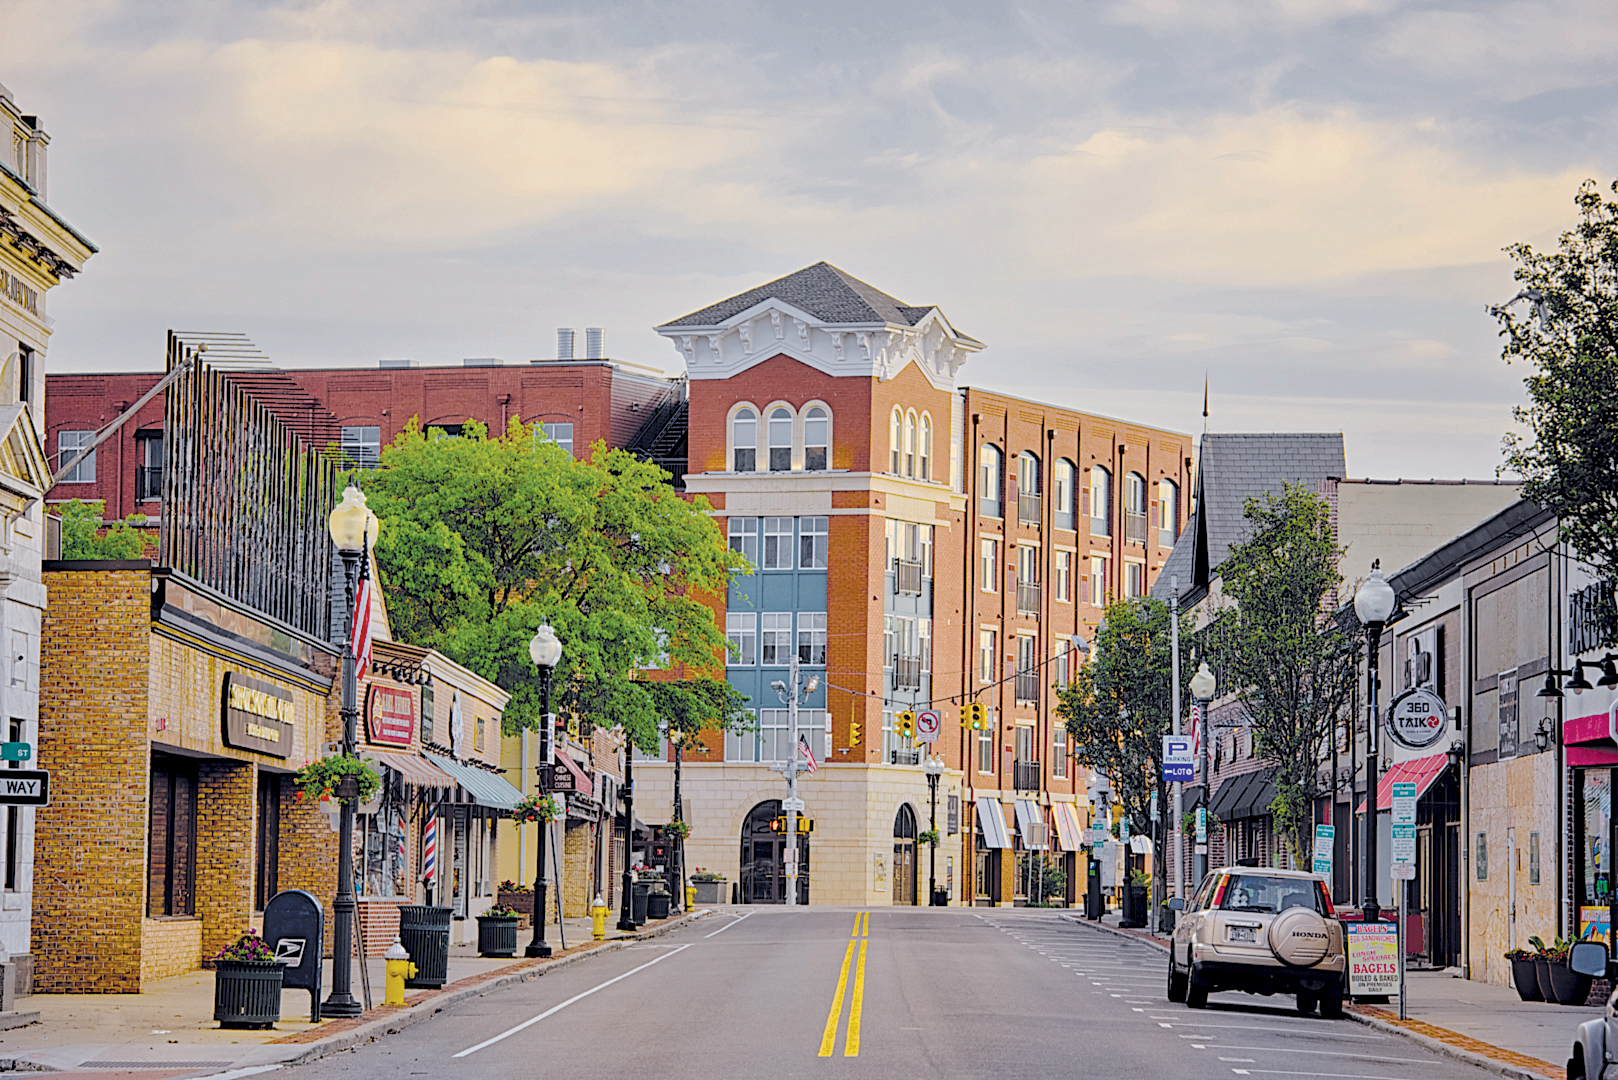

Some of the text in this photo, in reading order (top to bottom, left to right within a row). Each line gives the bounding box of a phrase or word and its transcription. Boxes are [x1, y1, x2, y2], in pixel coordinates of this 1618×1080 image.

[1406, 702, 1429, 713] 360
[17, 749, 29, 757] ST
[1168, 742, 1188, 756] P
[554, 774, 572, 782] CHINESE
[6, 780, 37, 795] WAY
[554, 781, 572, 789] CUISINE
[1357, 924, 1387, 933] BAGELS
[1292, 931, 1328, 939] HONDA
[1350, 935, 1396, 944] EGG SANDWICHES
[1352, 950, 1376, 958] LUNCH
[1362, 954, 1397, 962] SPECIALS
[1353, 963, 1396, 974] BAGELS
